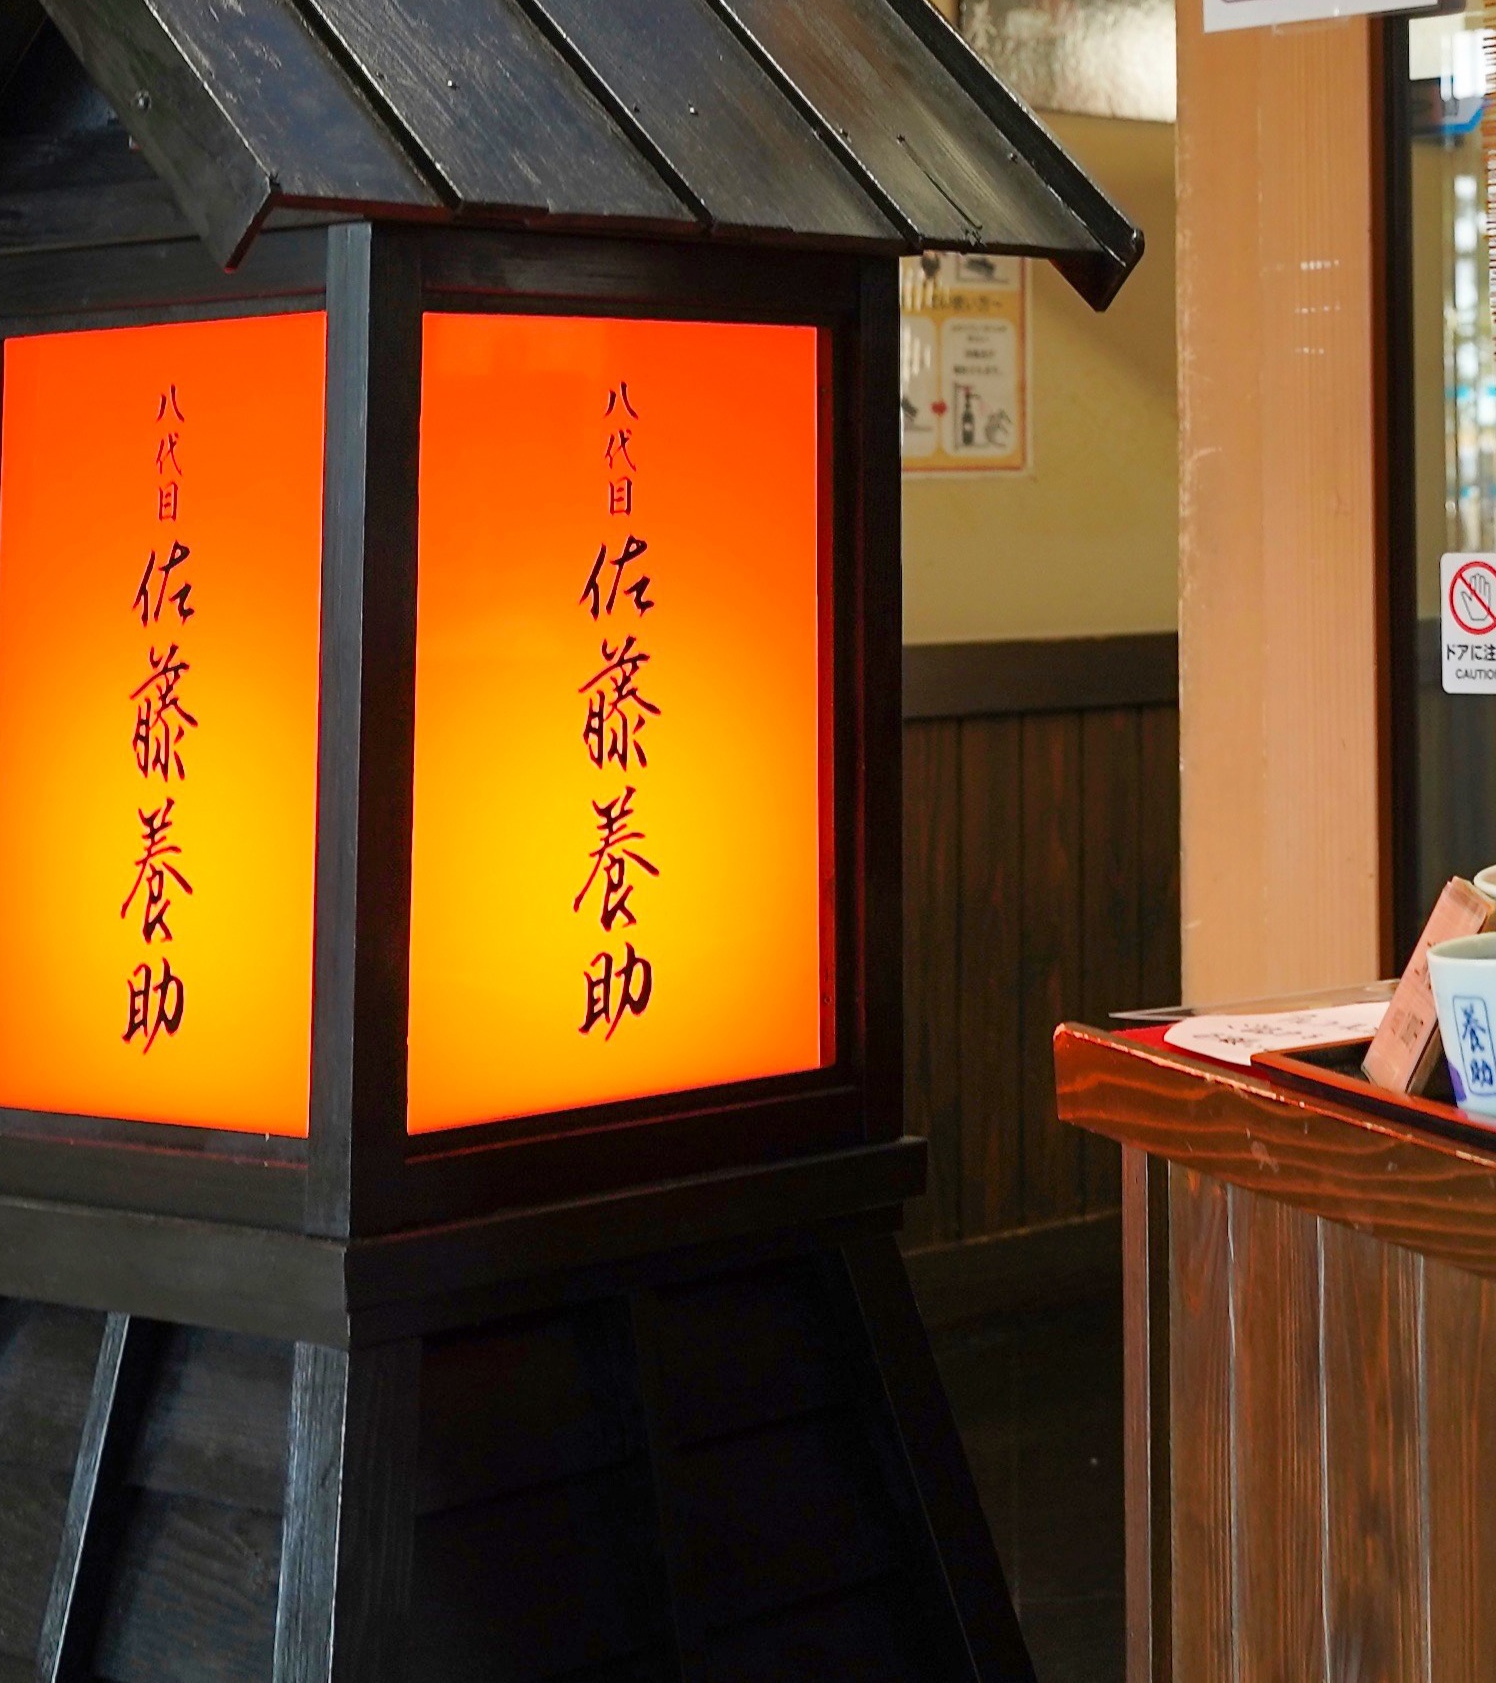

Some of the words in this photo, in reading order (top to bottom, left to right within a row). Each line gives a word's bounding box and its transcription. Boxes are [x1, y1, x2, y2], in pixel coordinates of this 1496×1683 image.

[154, 382, 186, 523] 八代目
[603, 381, 640, 518] 八代目
[120, 539, 198, 1055] 佐藤養助
[574, 534, 662, 1042] 佐藤養助
[1461, 1003, 1495, 1088] 養助
